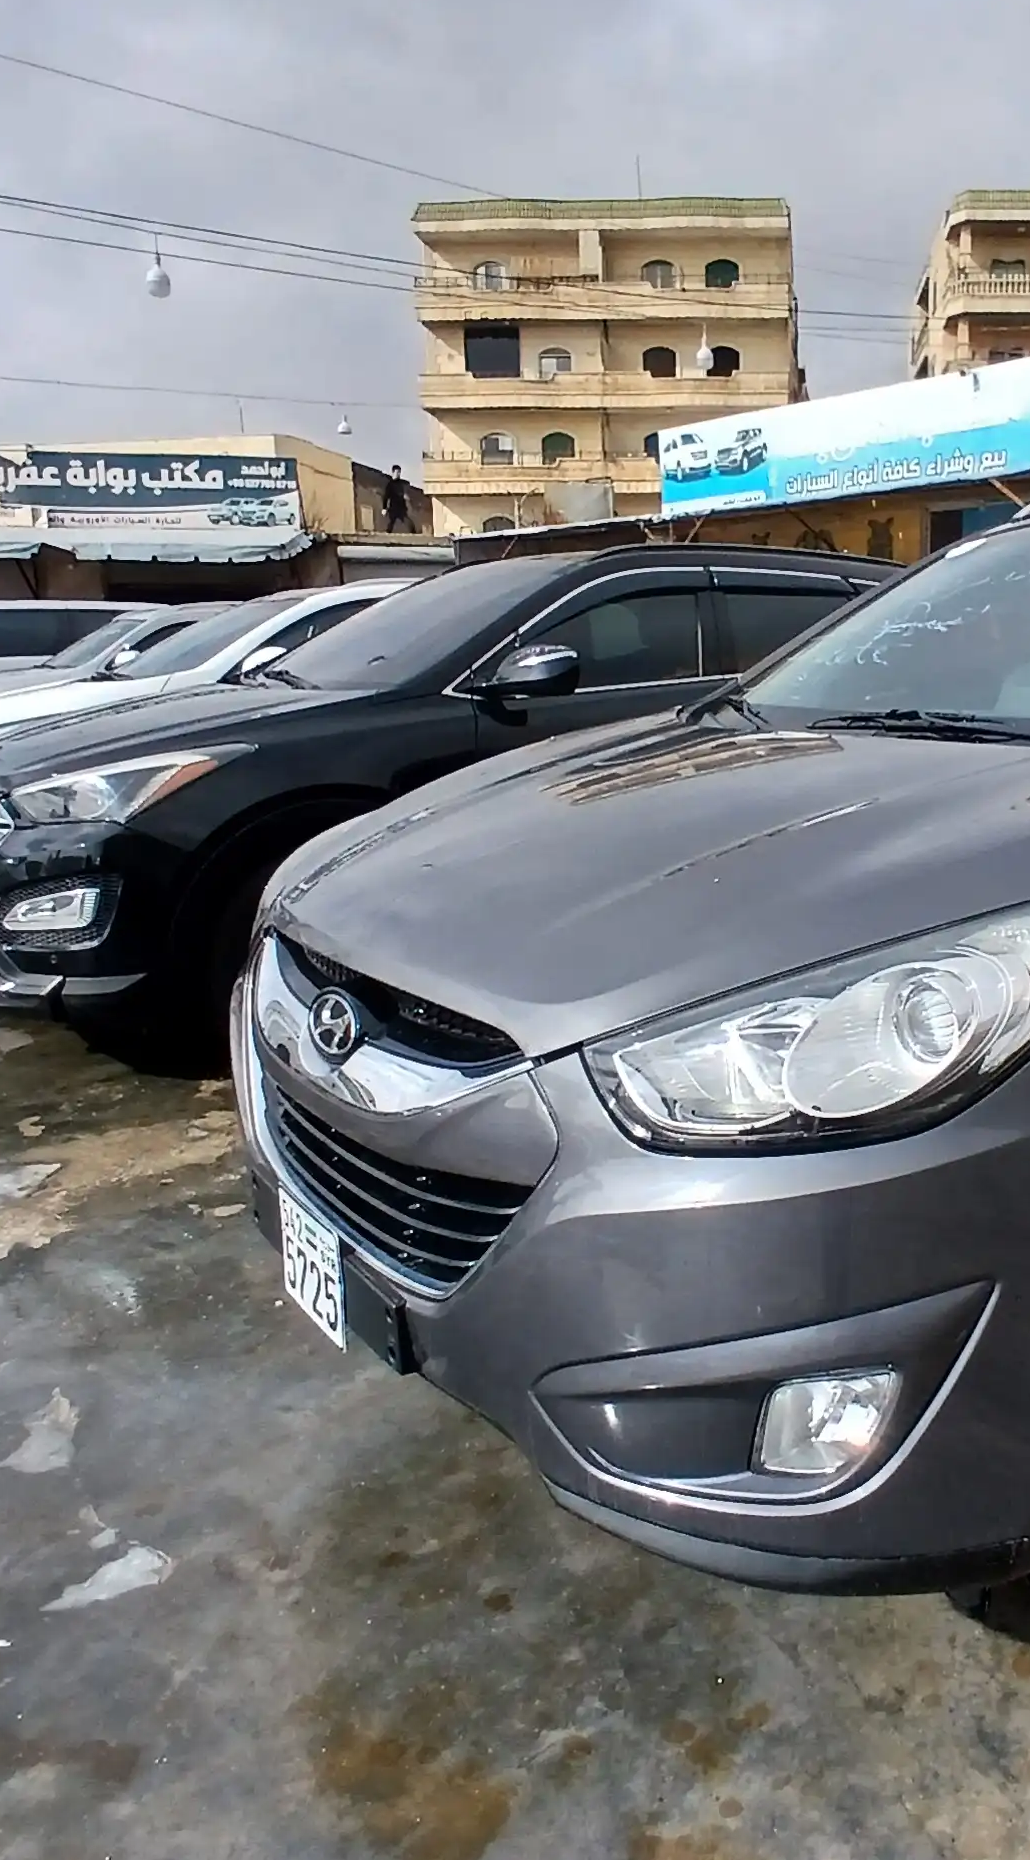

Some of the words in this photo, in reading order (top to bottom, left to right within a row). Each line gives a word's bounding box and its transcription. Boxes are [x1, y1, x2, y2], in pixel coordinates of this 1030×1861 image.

[882, 457, 921, 482] كافة
[926, 448, 974, 478] وشراء
[979, 450, 1008, 473] بيع
[66, 459, 137, 495] بوابة
[141, 459, 224, 496] مكتب
[785, 468, 838, 497] السيارات
[113, 516, 151, 526] السيارات
[285, 1236, 339, 1332] 5725
